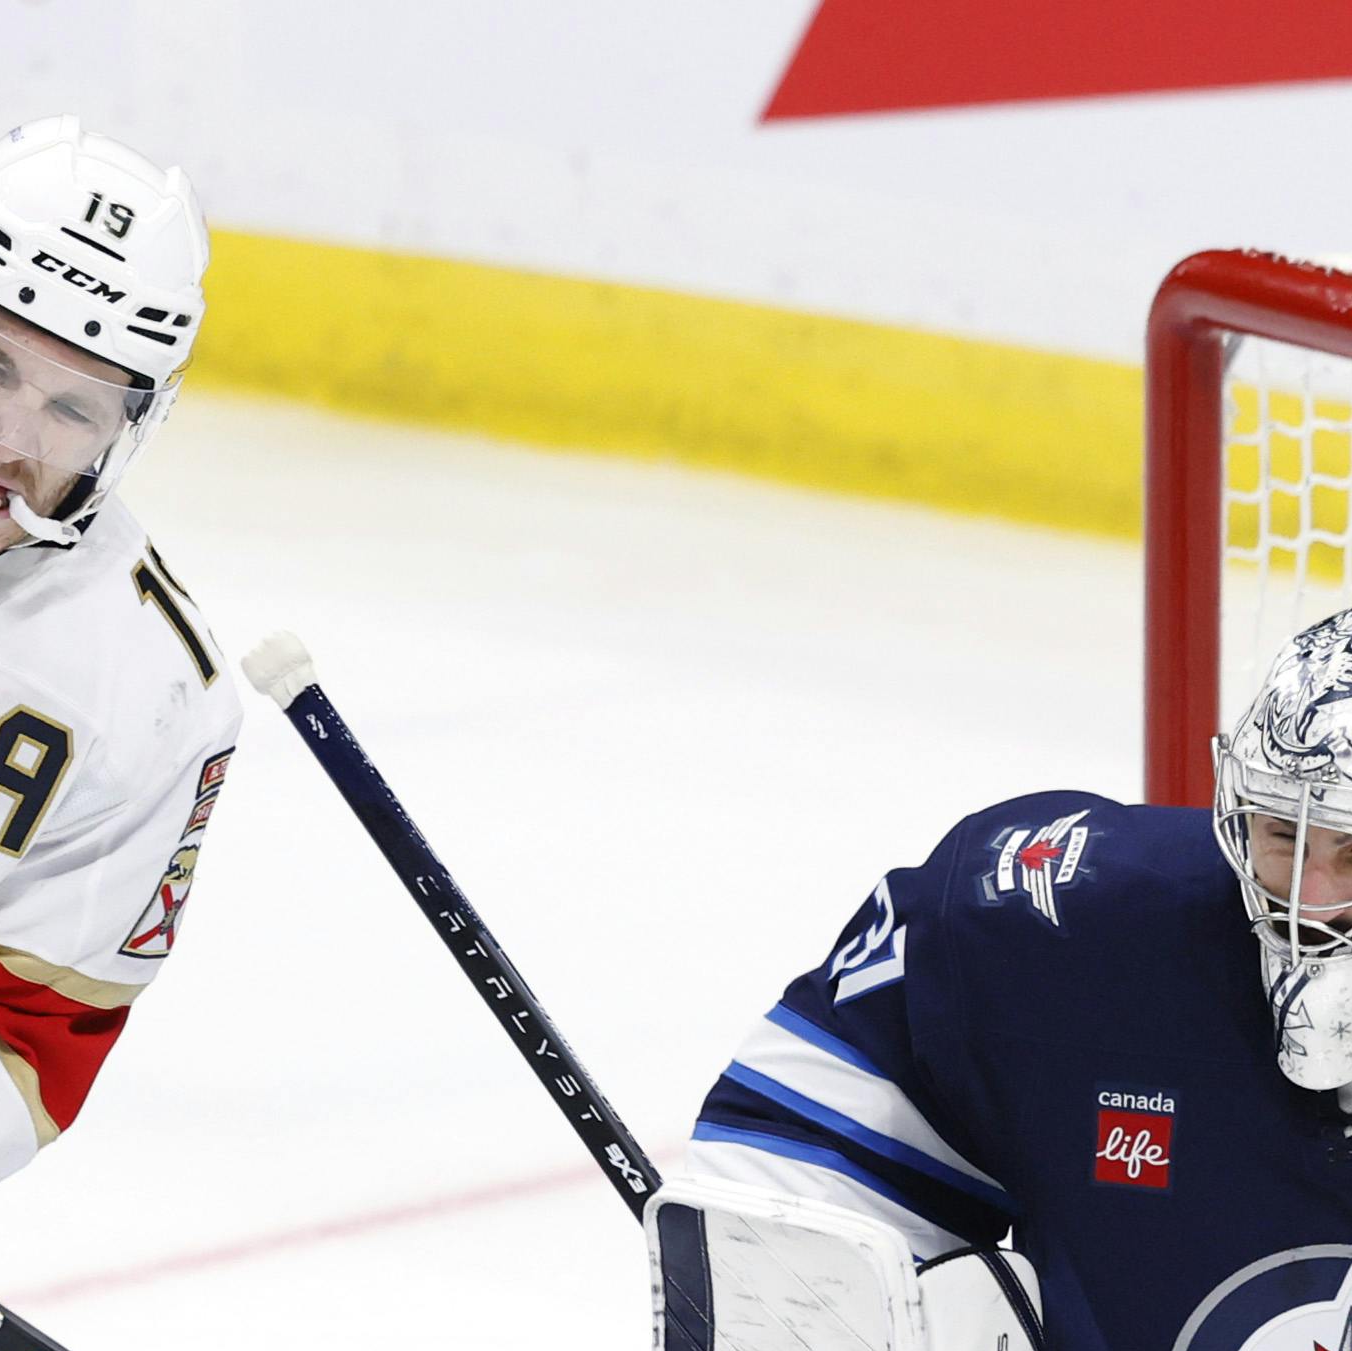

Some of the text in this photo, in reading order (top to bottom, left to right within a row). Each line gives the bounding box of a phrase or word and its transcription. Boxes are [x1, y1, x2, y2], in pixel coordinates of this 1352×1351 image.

[84, 191, 135, 239] 19
[32, 250, 127, 303] CCM
[414, 873, 604, 1124] CATALYST
[1098, 1091, 1175, 1114] canada
[1095, 1126, 1170, 1179] life
